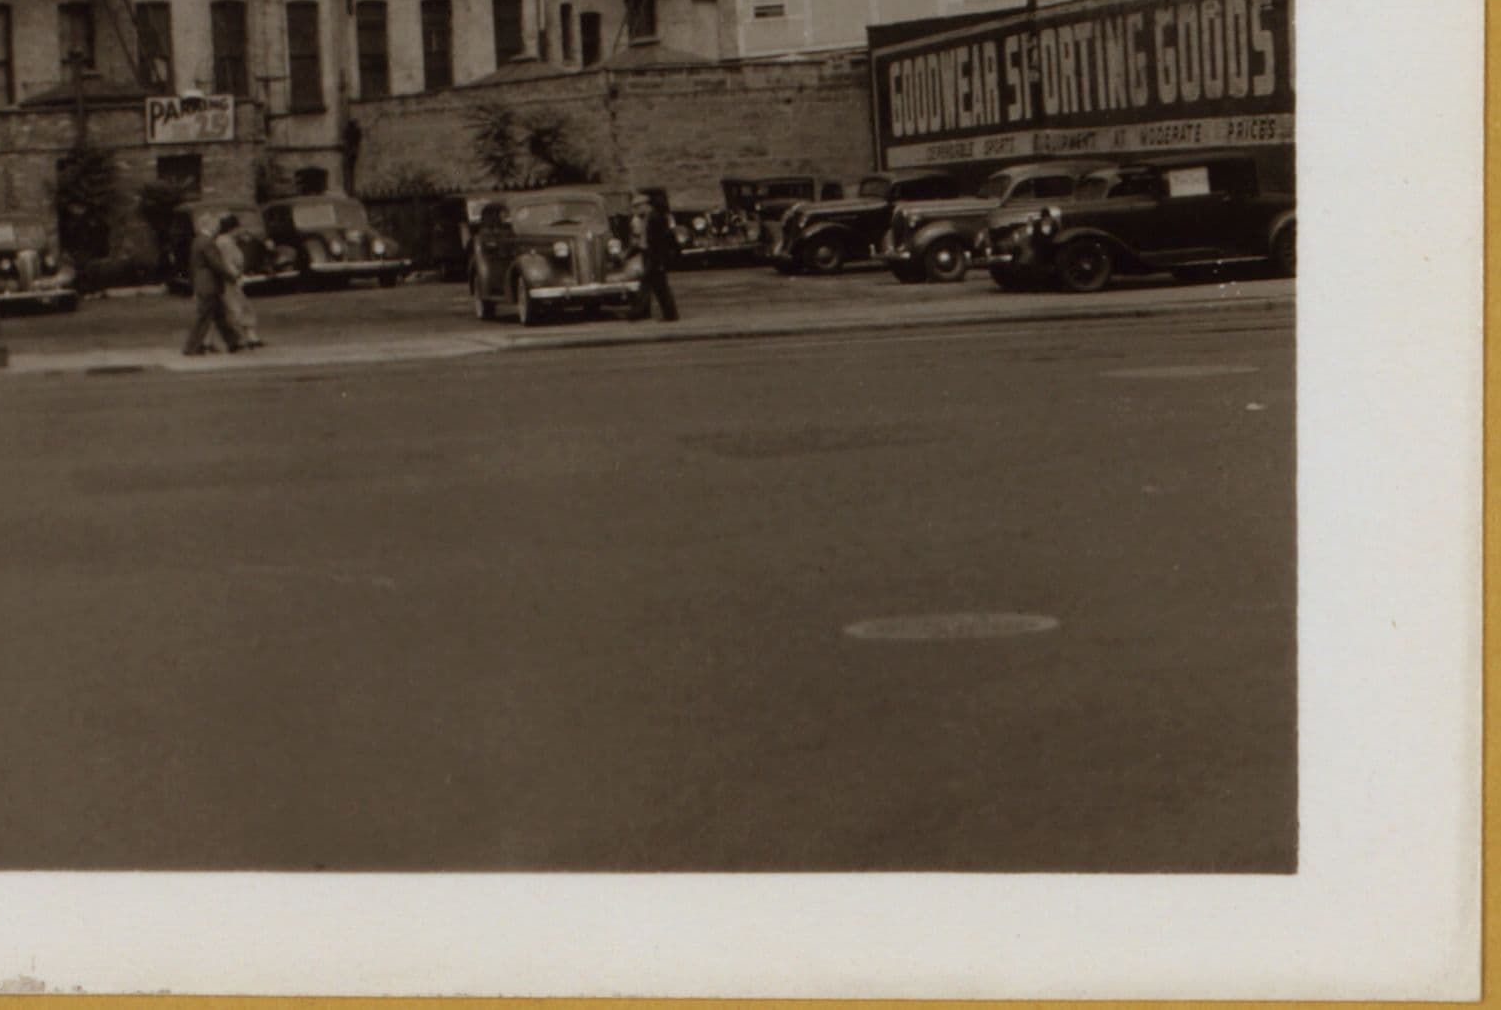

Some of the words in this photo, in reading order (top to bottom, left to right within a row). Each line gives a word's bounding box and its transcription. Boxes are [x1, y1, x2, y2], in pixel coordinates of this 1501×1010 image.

[890, 41, 1001, 137] GOODWEAR
[1004, 11, 1148, 123] SPORTING
[1139, 123, 1202, 146] MODERATE
